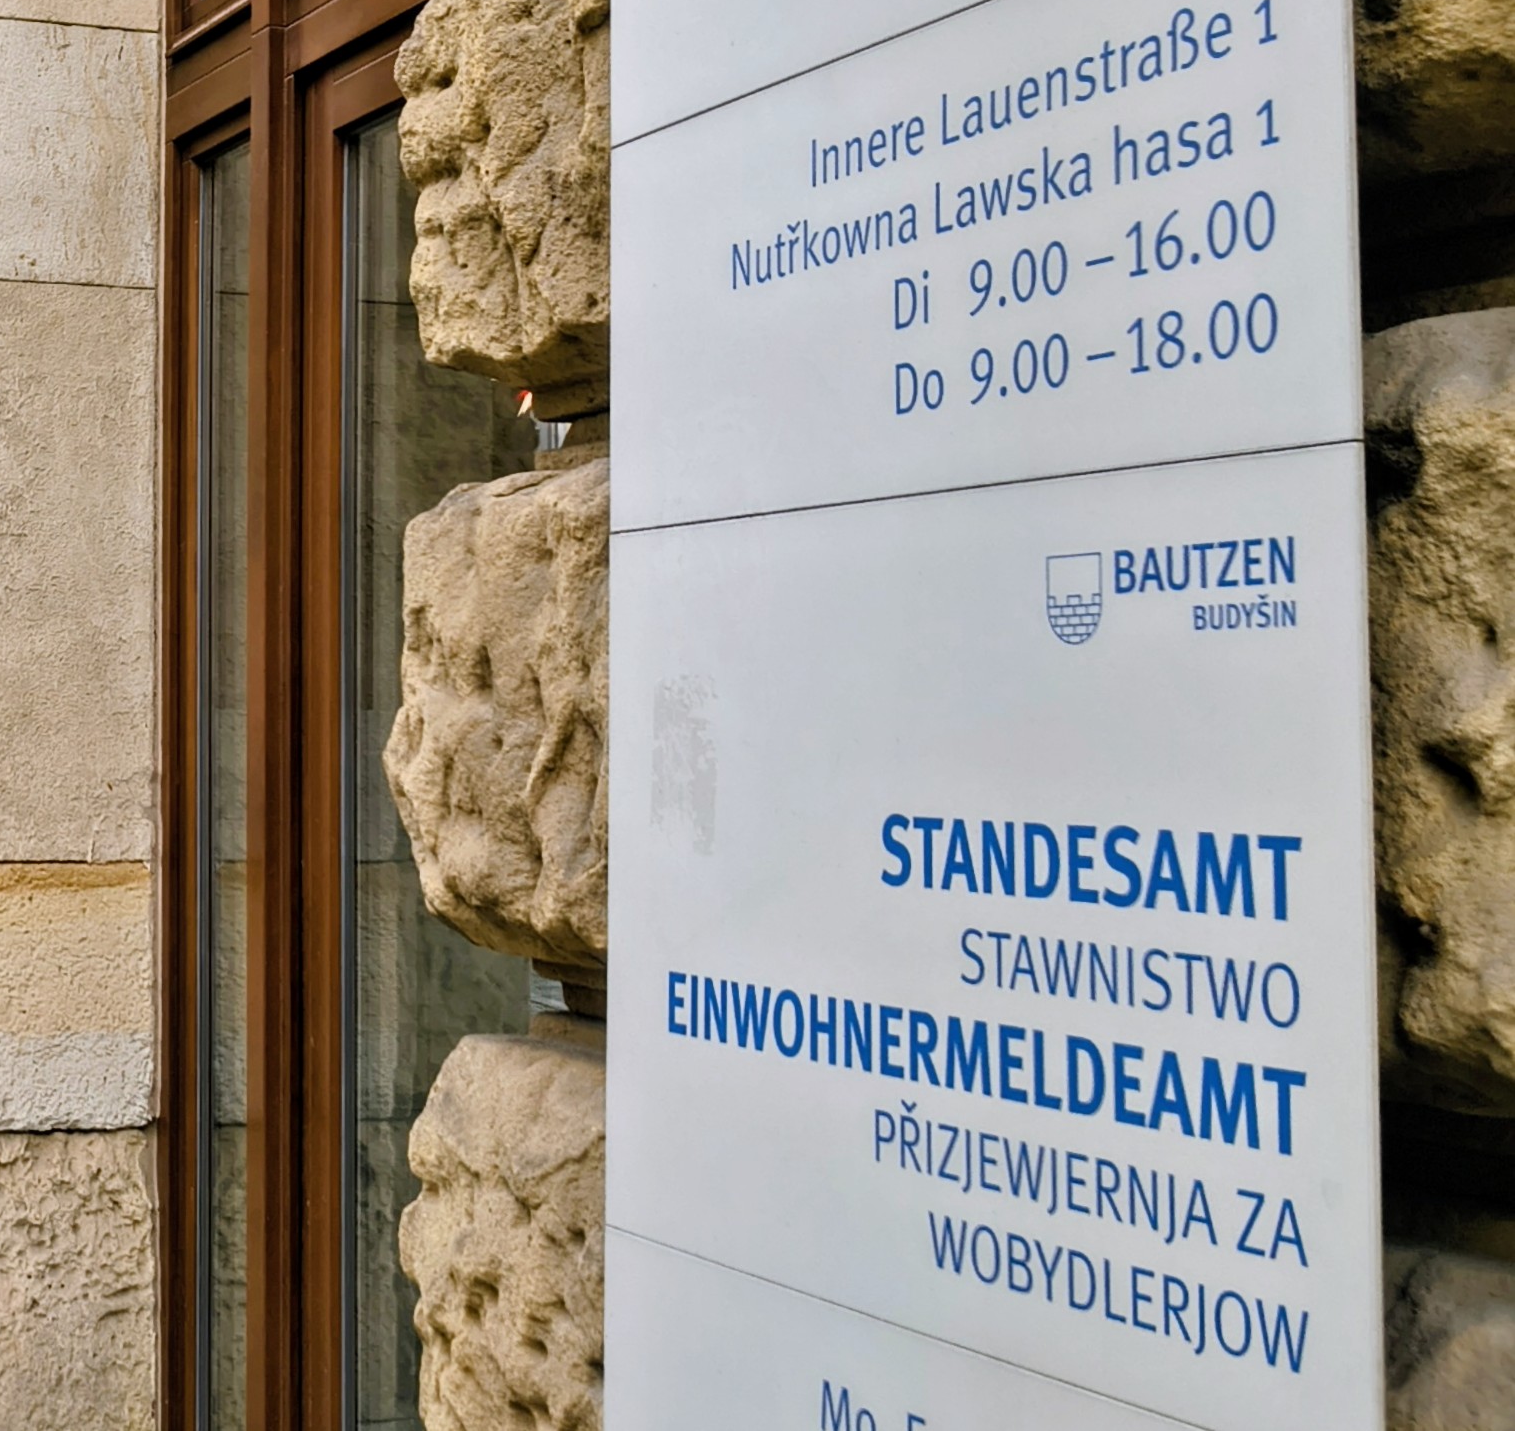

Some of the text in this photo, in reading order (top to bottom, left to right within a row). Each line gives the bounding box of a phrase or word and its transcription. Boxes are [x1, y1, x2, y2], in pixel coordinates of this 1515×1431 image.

[811, 116, 926, 188] Innere
[941, 8, 1234, 146] Lauenstraße
[731, 99, 1281, 291] Nutřkowna Lawska hasa 1
[894, 270, 930, 331] Di
[969, 241, 1069, 317] 9.00
[894, 362, 945, 416] Do
[970, 333, 1070, 406] 9.00
[1113, 536, 1297, 595] BAUTZEN
[1192, 593, 1297, 632] BUDYŠIN
[880, 813, 1303, 922] STANDESAMT
[960, 927, 1301, 1029] STAWNISTWO
[667, 971, 1308, 1157] EINWOHNERMELDEAMT
[874, 1099, 1310, 1268] PŘIZJEWJERNJA ZA
[928, 1211, 1310, 1375] WOBYDLERJOW
